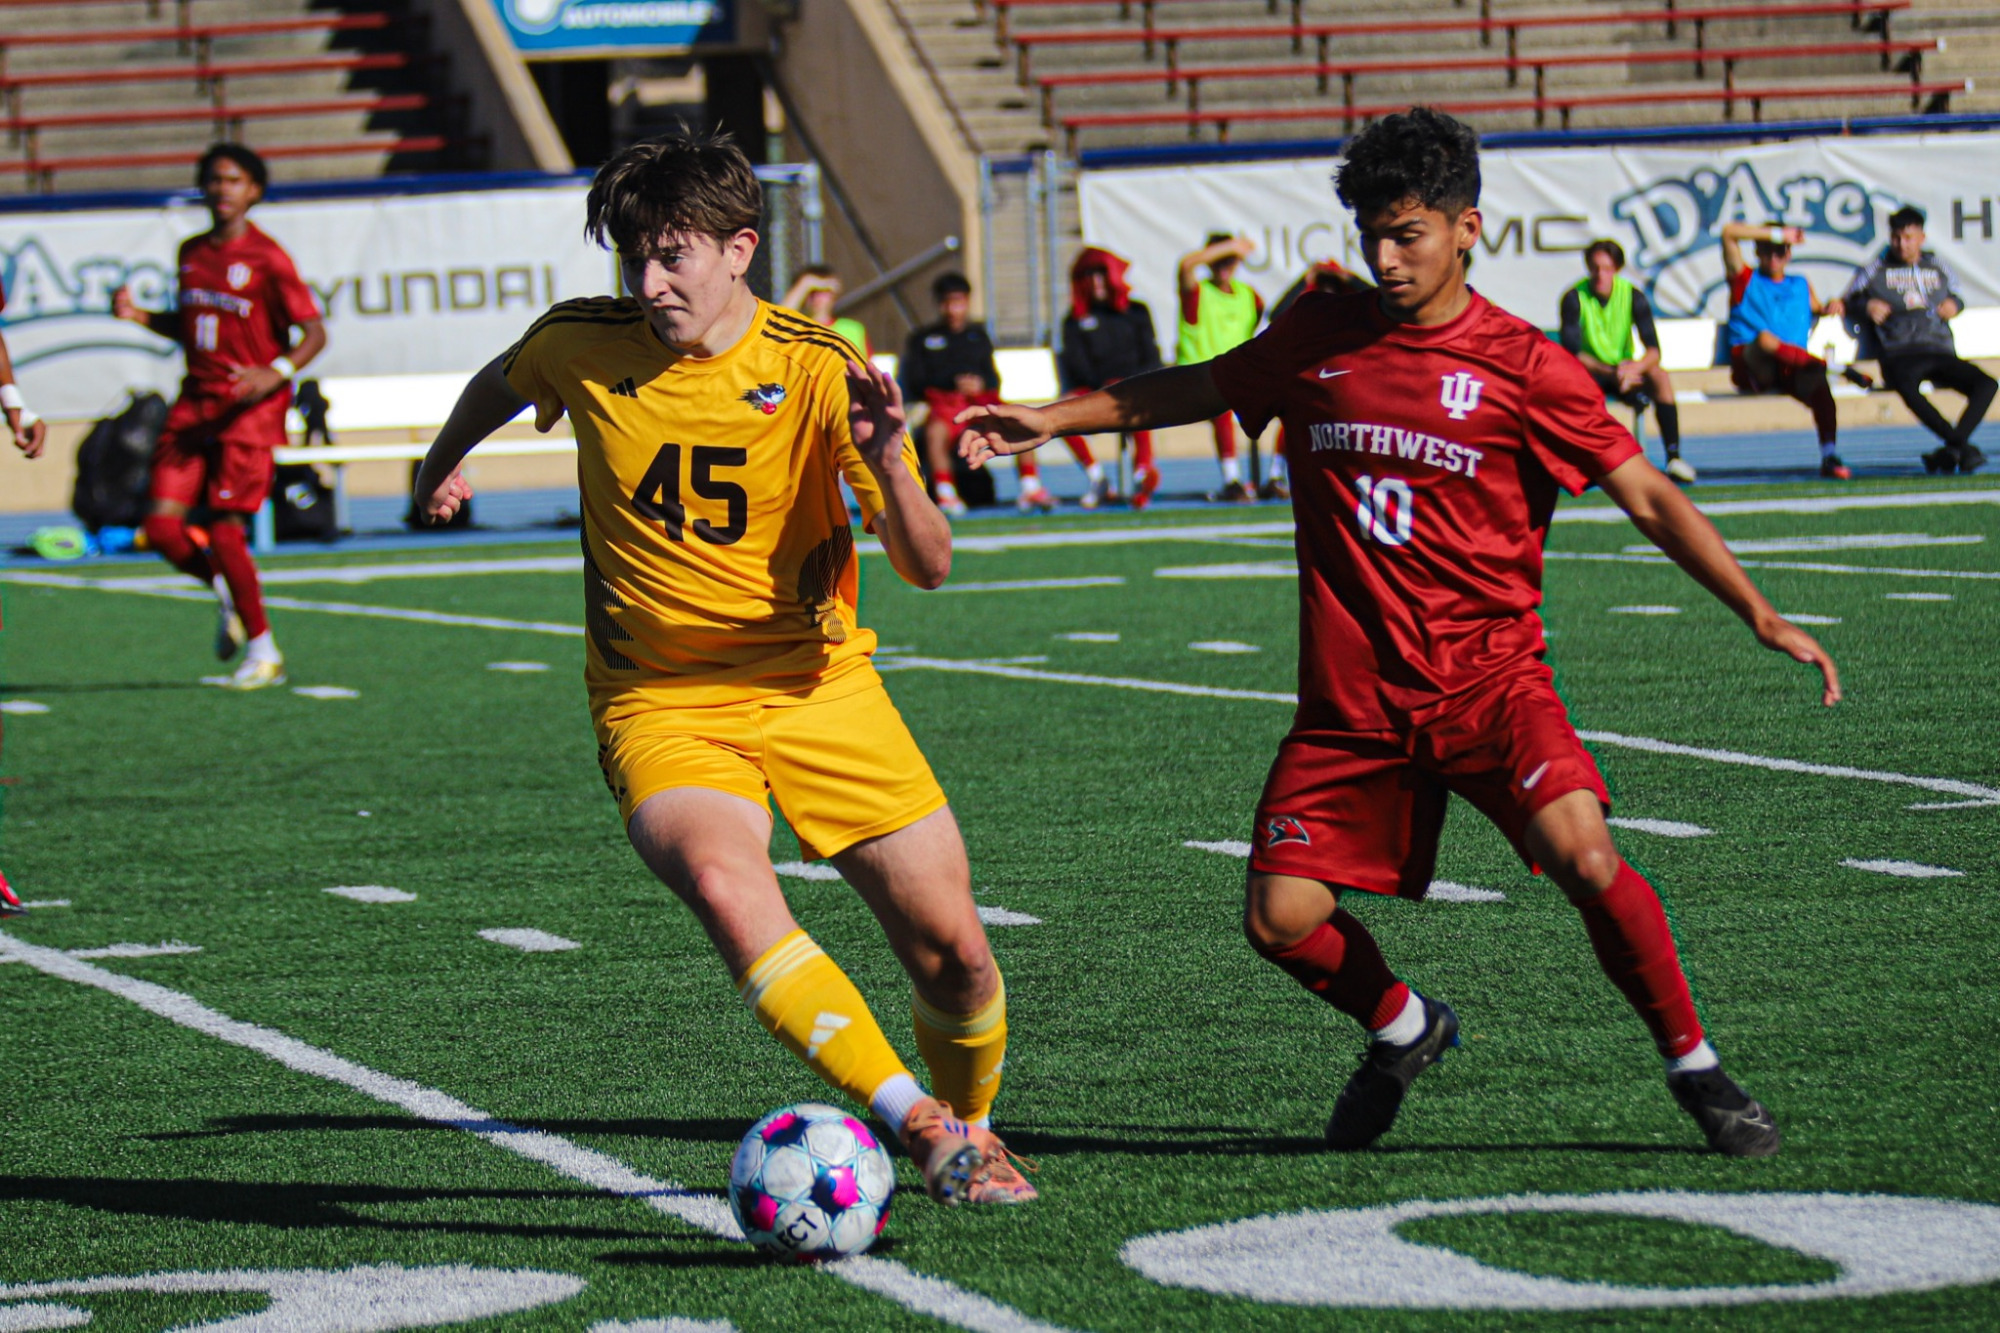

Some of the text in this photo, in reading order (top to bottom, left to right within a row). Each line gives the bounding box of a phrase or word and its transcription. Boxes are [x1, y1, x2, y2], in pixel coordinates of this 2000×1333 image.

[1480, 215, 1588, 255] MC
[308, 264, 555, 318] YUNDAI
[1309, 422, 1483, 478] NORTHWEST
[631, 442, 748, 545] 45
[1355, 474, 1413, 545] 10
